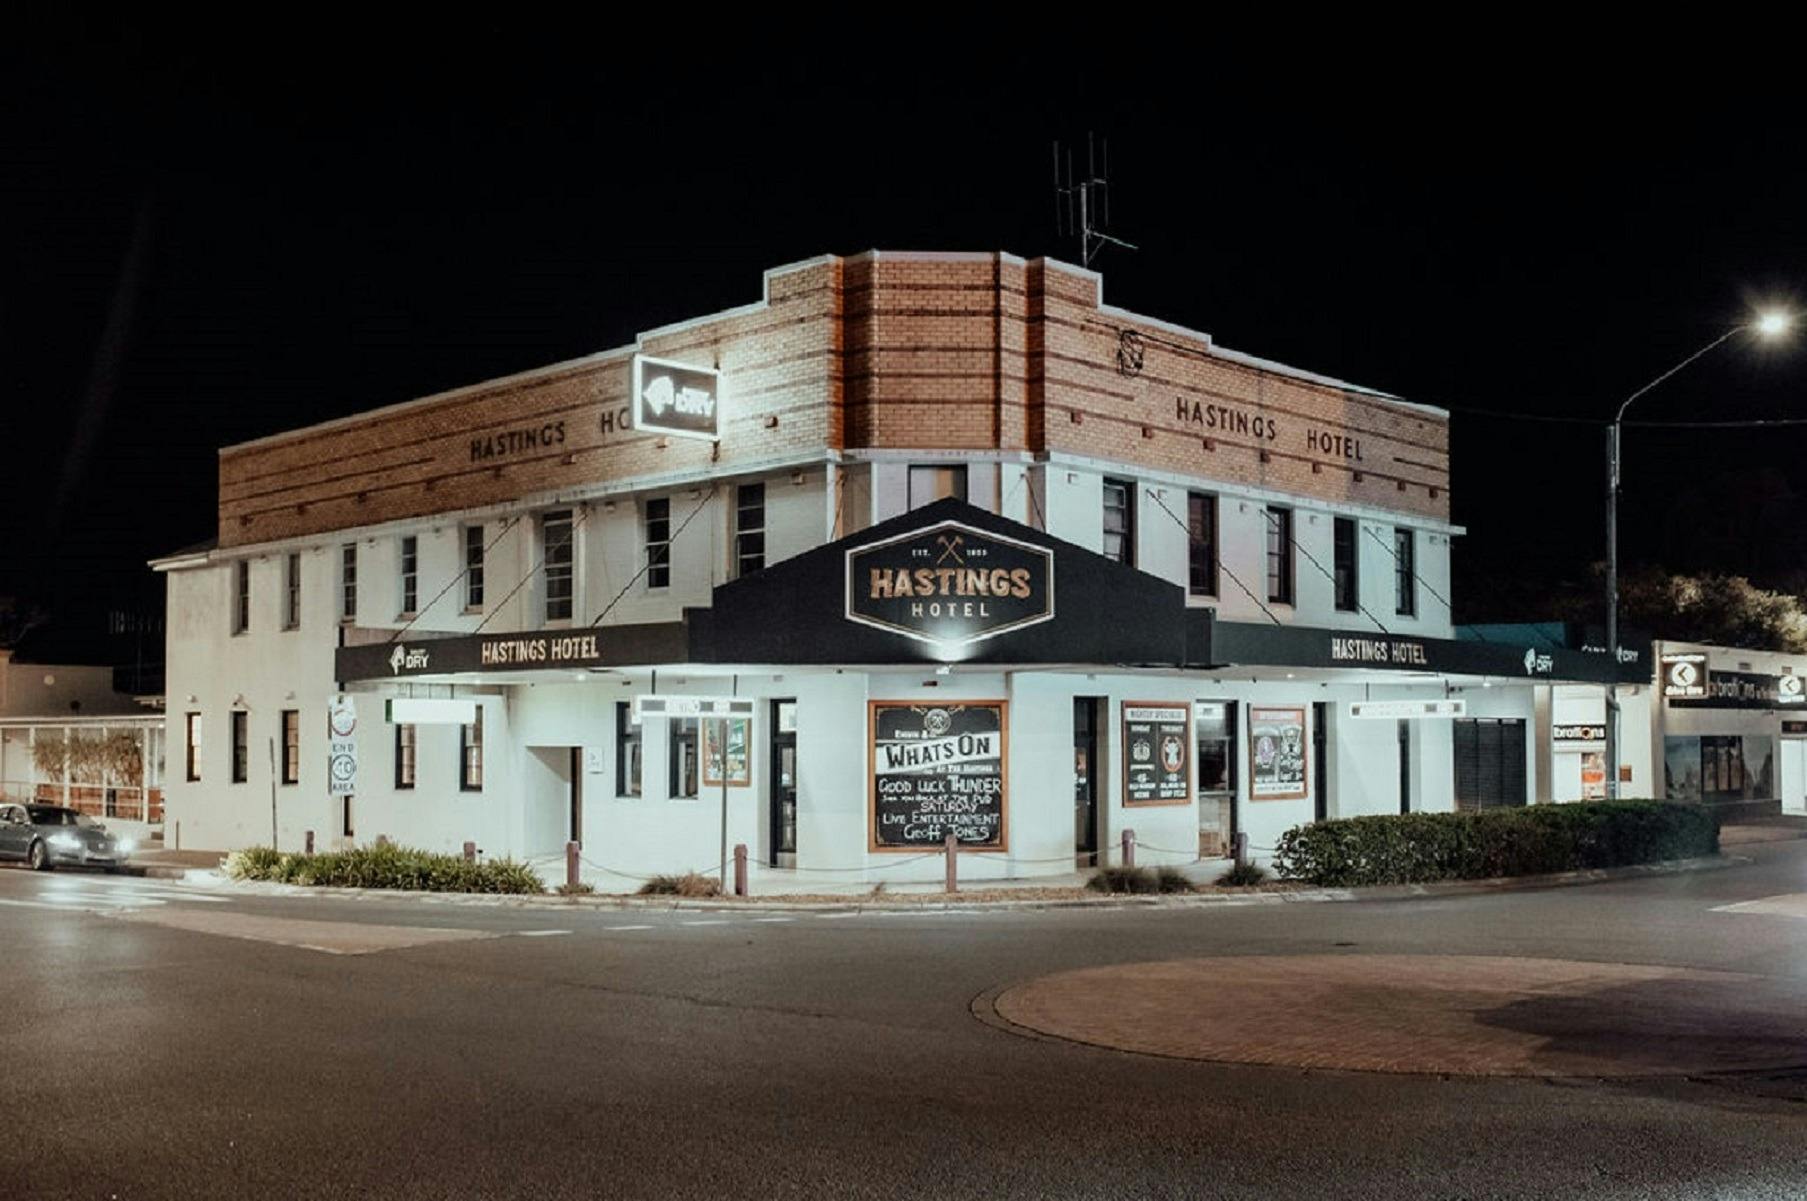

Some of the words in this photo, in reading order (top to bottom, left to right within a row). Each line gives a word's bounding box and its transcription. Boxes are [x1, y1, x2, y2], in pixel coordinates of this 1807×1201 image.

[1174, 396, 1277, 442] HASTINGS
[1306, 429, 1363, 462] HOTEL
[469, 420, 566, 464] HASTINGS
[870, 568, 1032, 599] HASTINGS
[911, 602, 990, 617] HOTEL
[481, 640, 547, 665] HASTINGS
[551, 636, 600, 659] HOTEL
[1331, 638, 1388, 661] HASTINGS
[1391, 642, 1427, 664] HOTEL
[405, 654, 430, 668] DRY
[1536, 659, 1553, 673] DRY
[332, 743, 354, 752] END
[334, 761, 352, 774] 40
[332, 783, 354, 791] AREA
